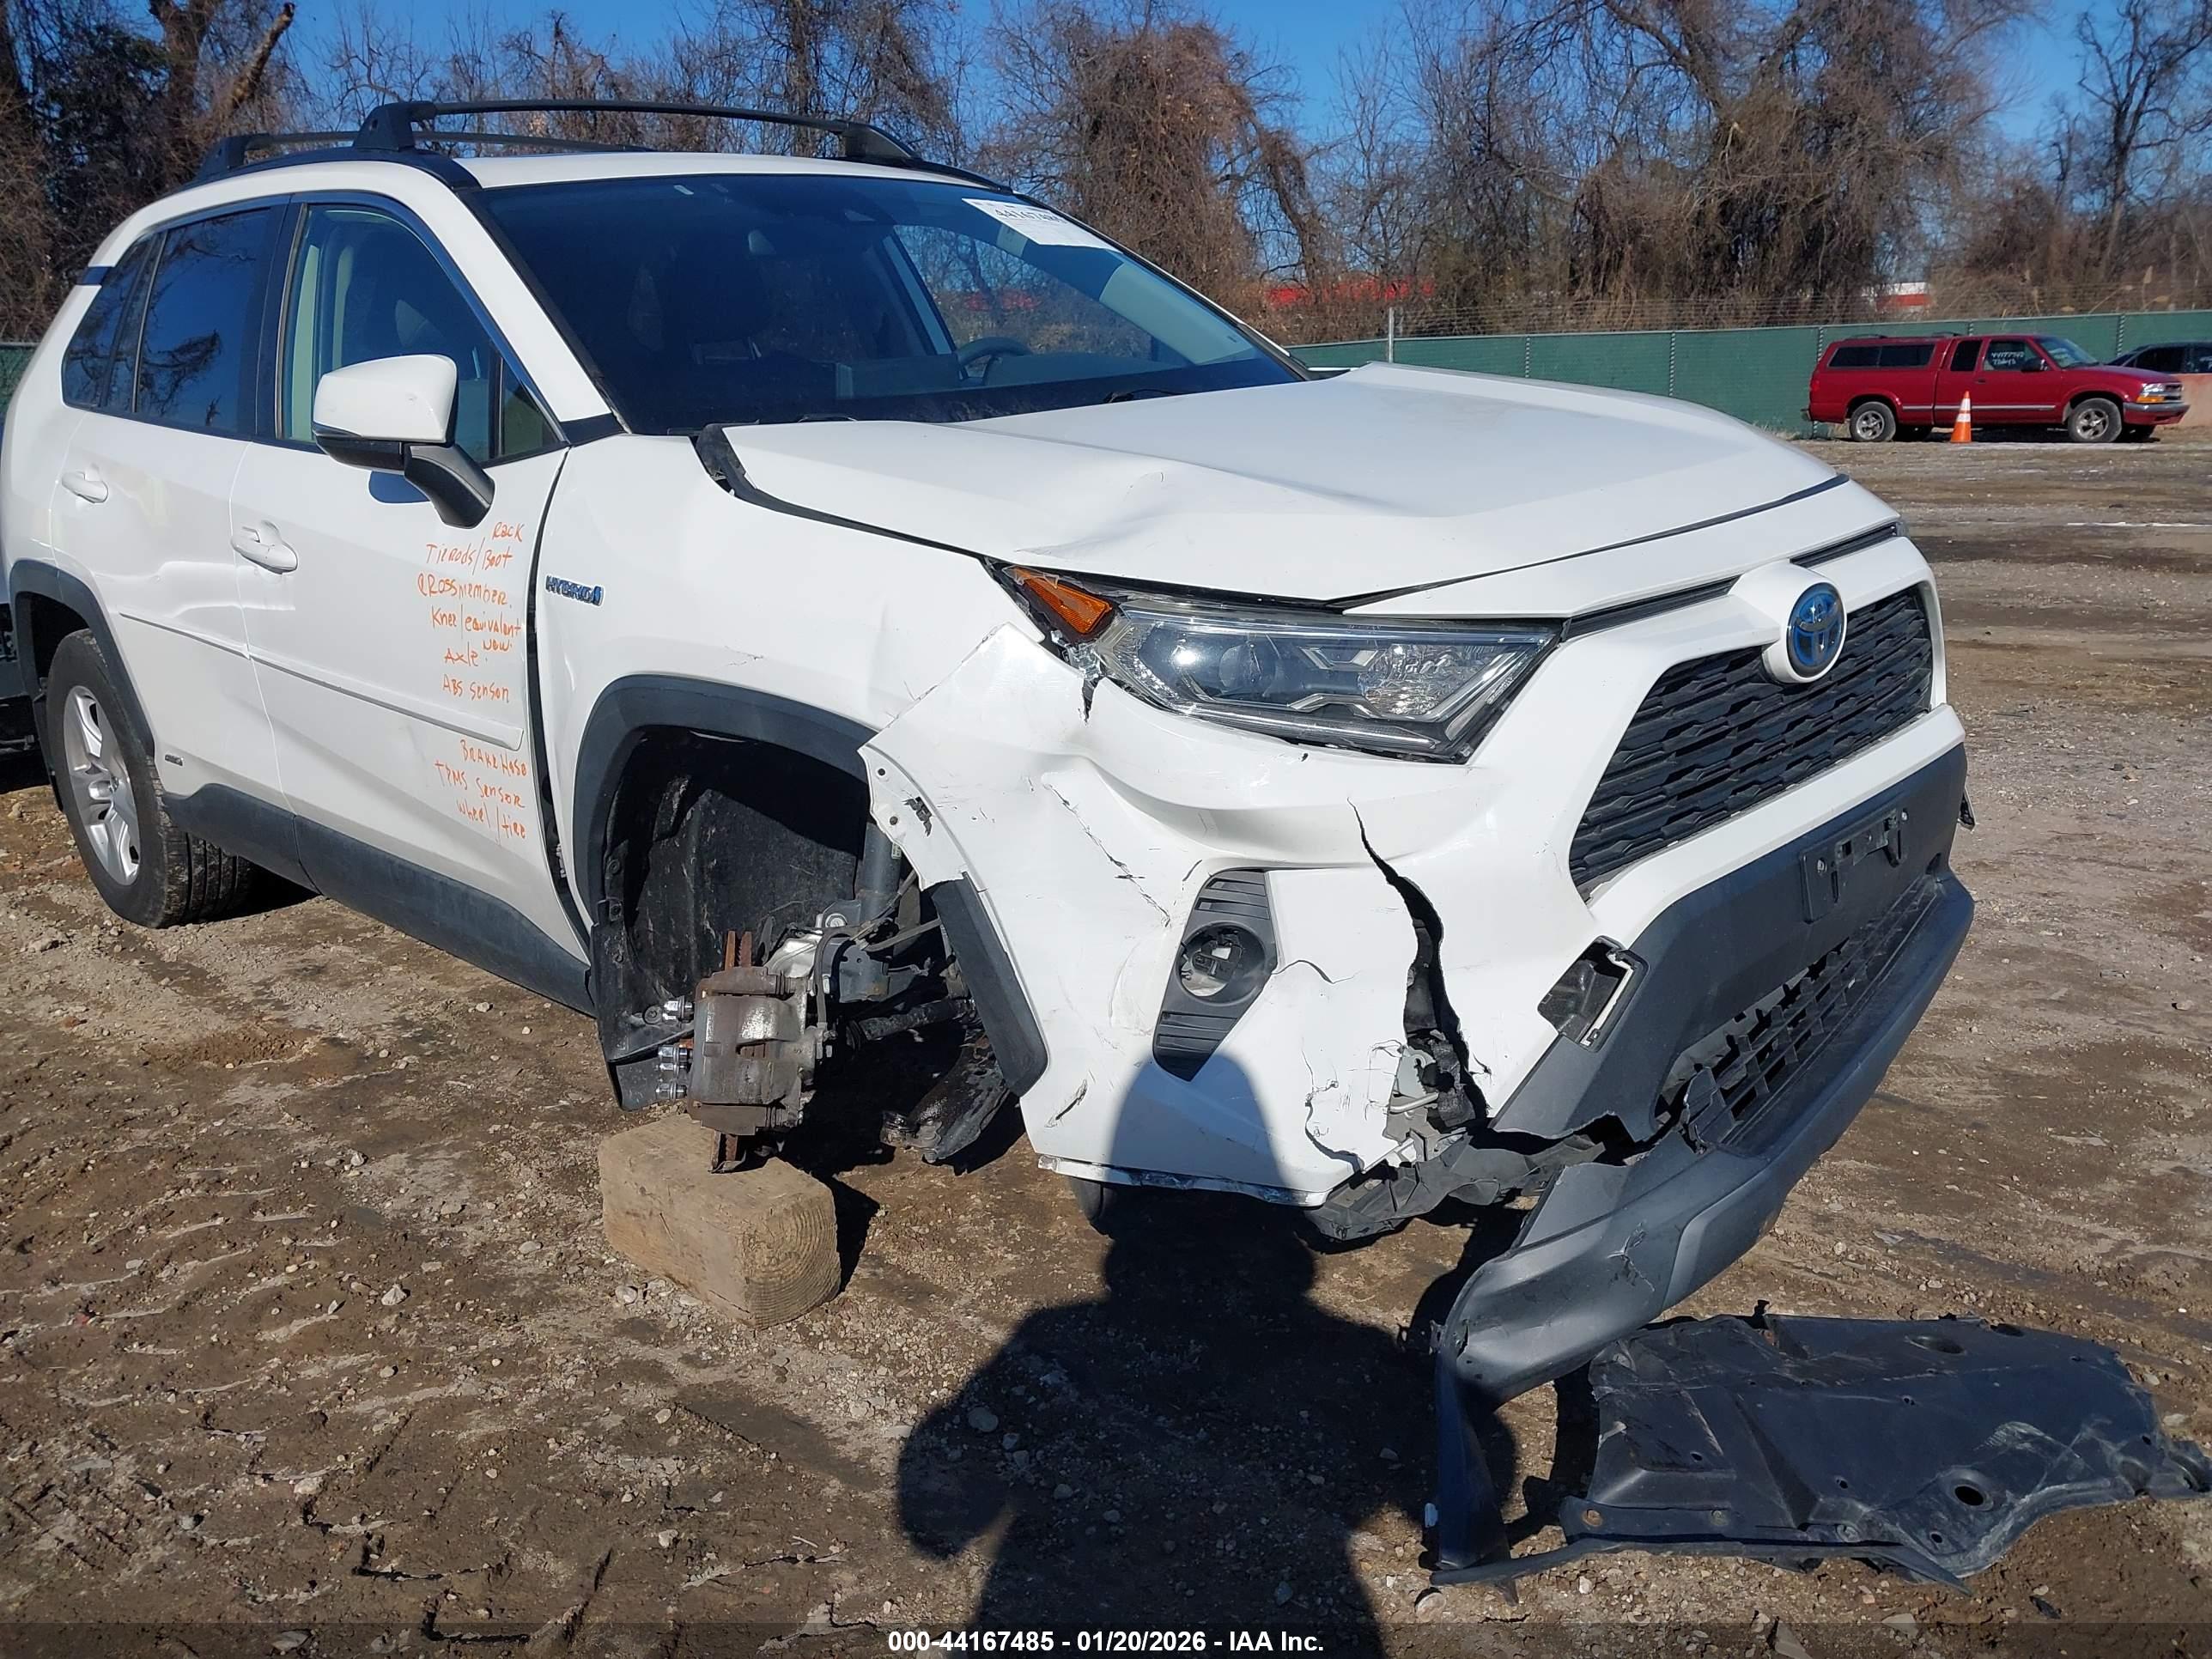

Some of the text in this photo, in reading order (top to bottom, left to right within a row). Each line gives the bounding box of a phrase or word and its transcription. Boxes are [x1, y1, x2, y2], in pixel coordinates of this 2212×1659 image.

[545, 575, 593, 604] HYBRID
[444, 641, 478, 667] Axle
[443, 673, 463, 697] ABS
[434, 759, 468, 790] TPMS
